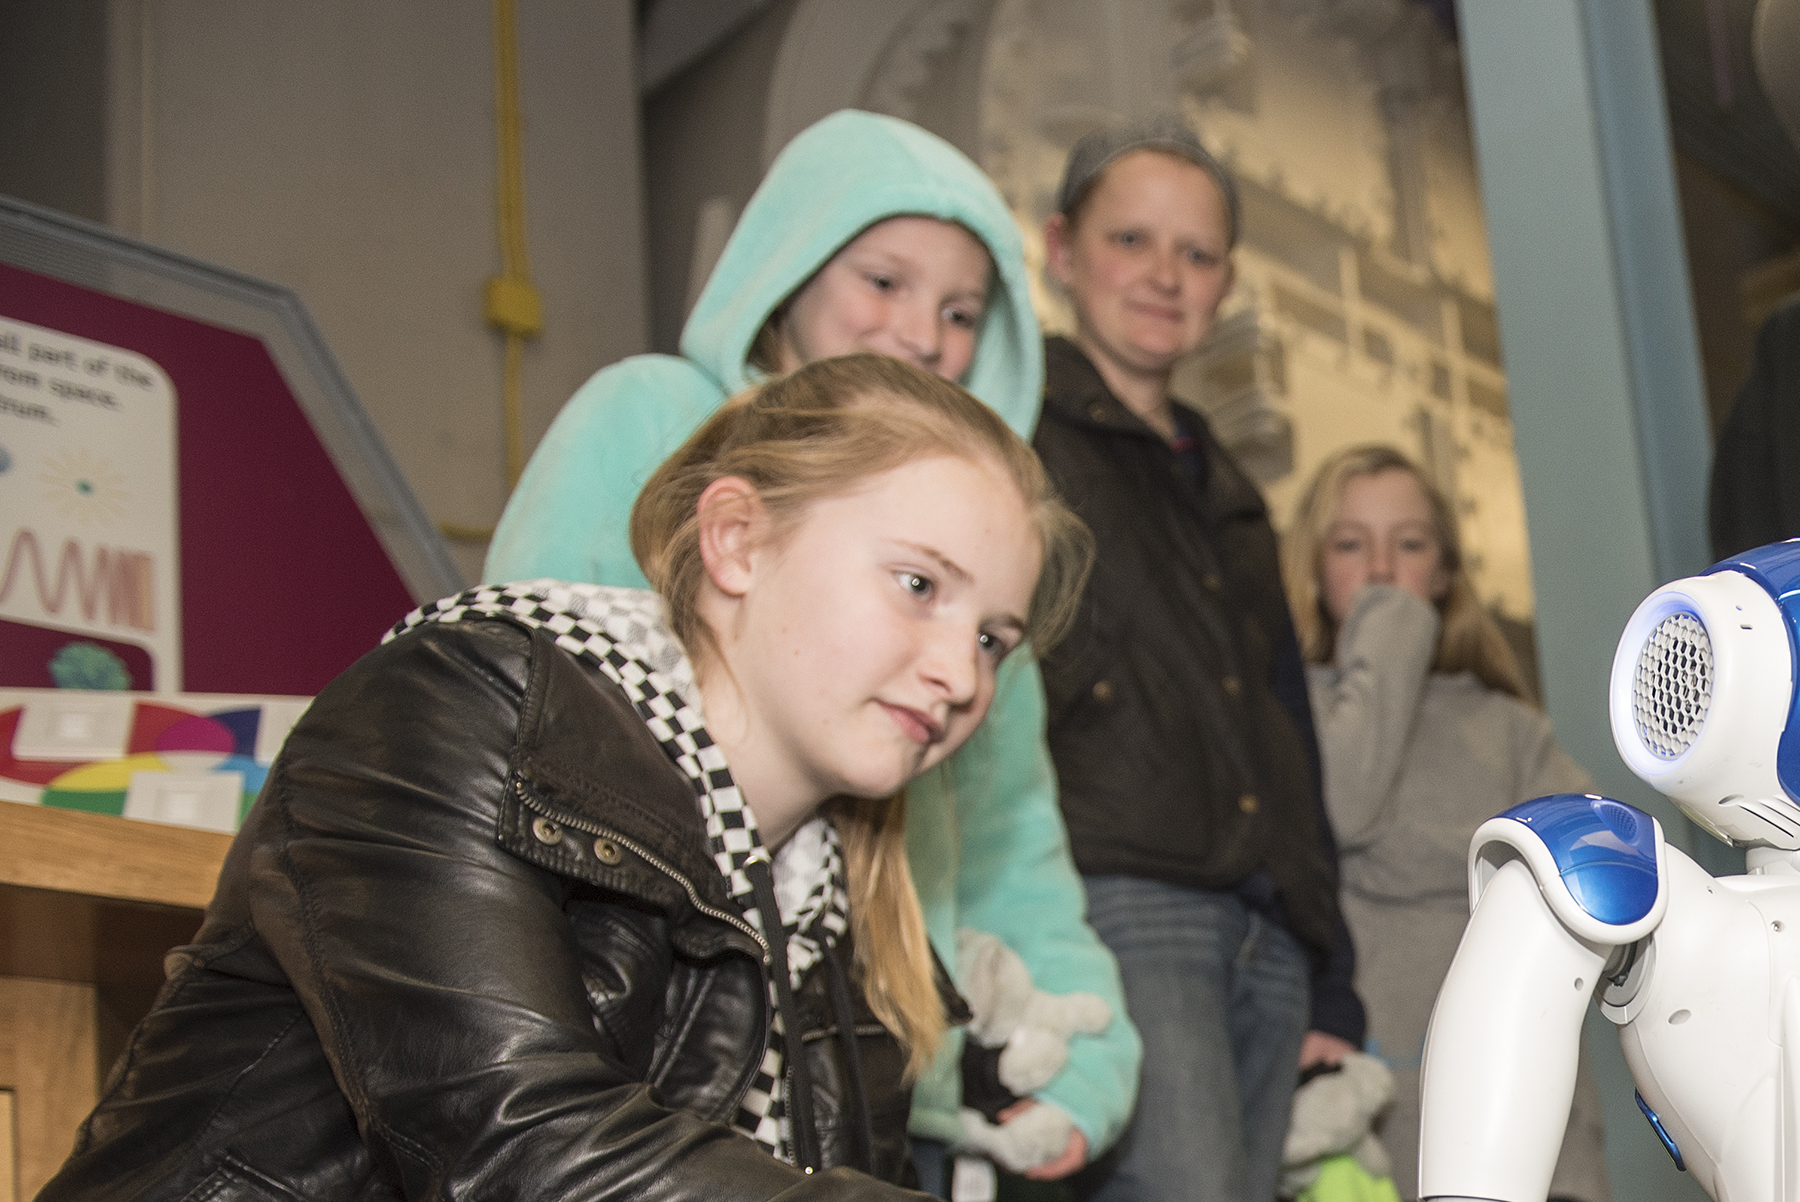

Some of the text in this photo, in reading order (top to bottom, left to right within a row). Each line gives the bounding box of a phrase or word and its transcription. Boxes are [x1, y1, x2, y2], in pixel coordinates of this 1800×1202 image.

[27, 342, 78, 370] part
[83, 356, 110, 376] of
[114, 362, 154, 391] the
